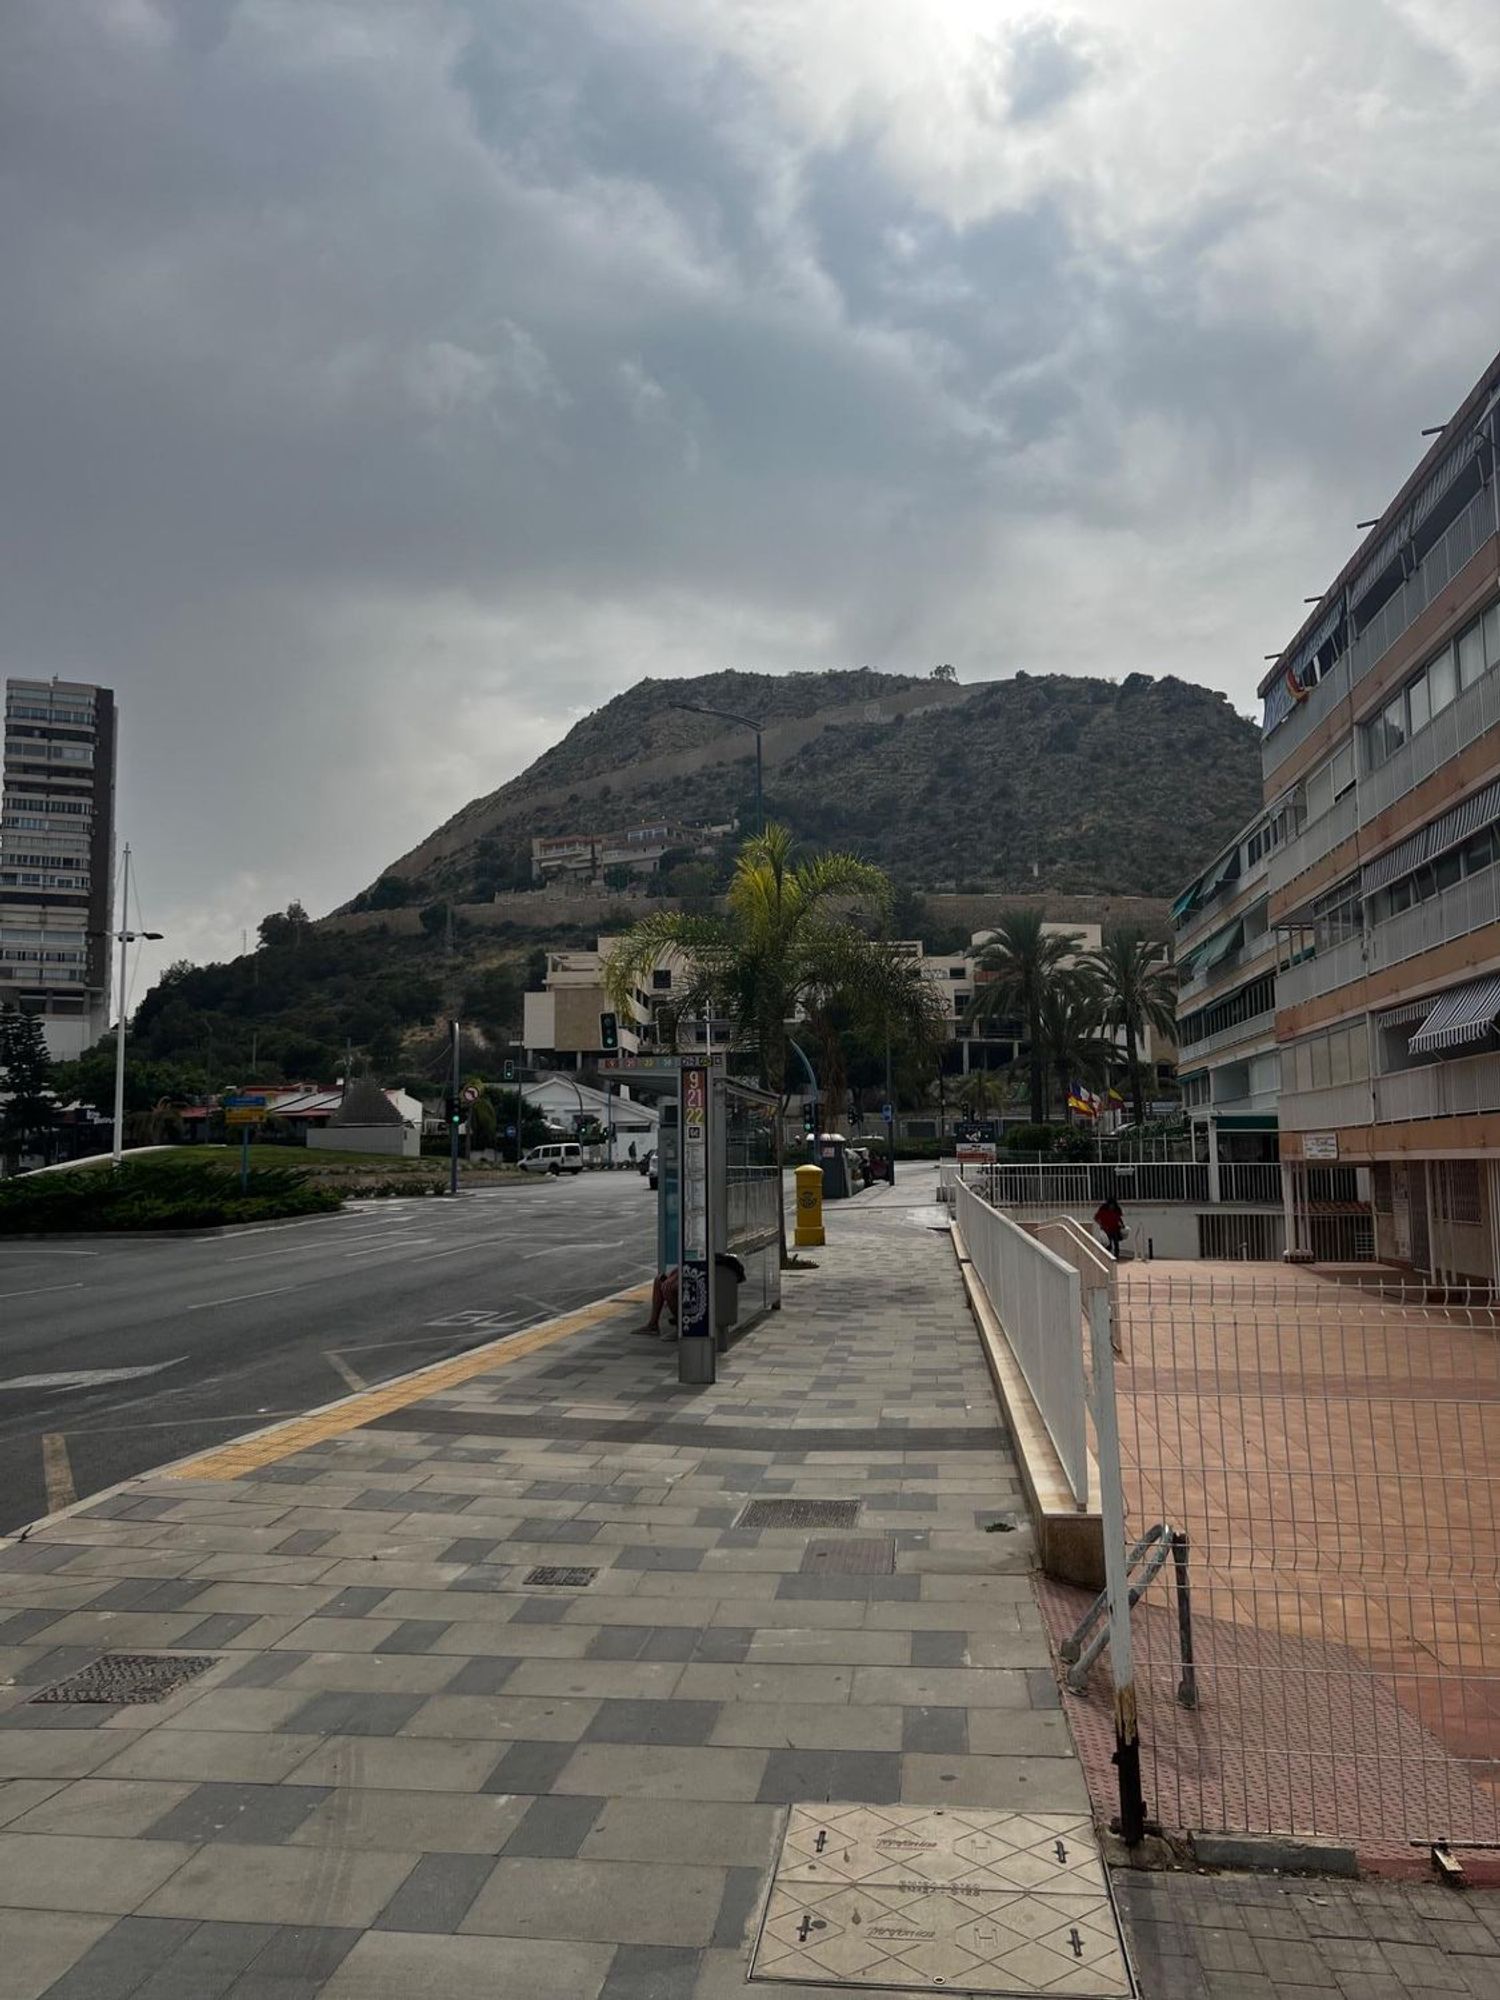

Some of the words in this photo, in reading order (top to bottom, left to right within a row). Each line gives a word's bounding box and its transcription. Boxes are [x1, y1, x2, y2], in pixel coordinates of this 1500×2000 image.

[689, 1071, 699, 1088] 9
[687, 1089, 702, 1107] 21
[686, 1108, 704, 1126] 22
